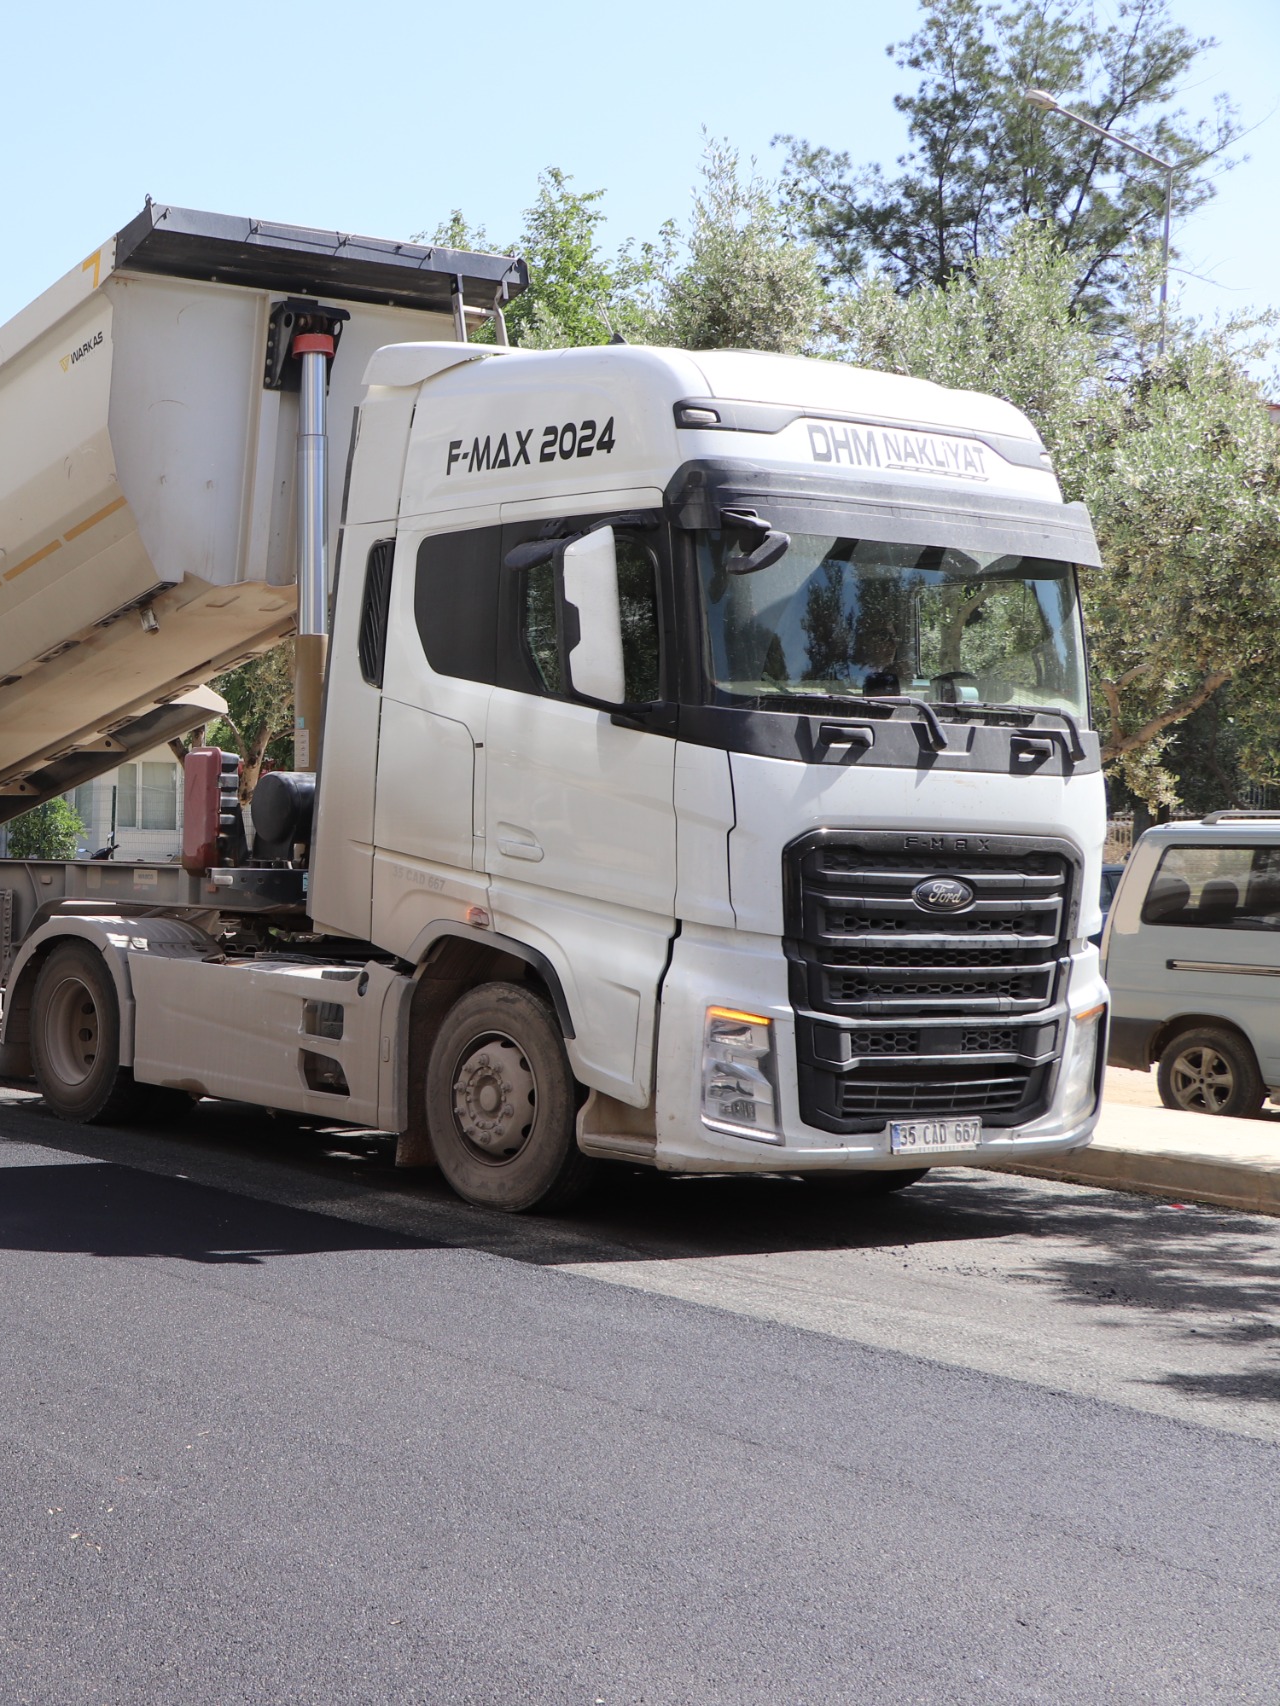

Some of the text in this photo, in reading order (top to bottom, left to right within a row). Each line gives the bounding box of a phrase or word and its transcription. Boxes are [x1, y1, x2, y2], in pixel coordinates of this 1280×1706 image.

[70, 331, 104, 365] WARKAS
[446, 416, 616, 476] F-MAX 2024
[806, 424, 881, 468] DHM
[903, 836, 990, 851] F-MAX
[428, 876, 446, 891] 667
[928, 883, 963, 903] Ford
[901, 1122, 979, 1146] 35 CAD 667
